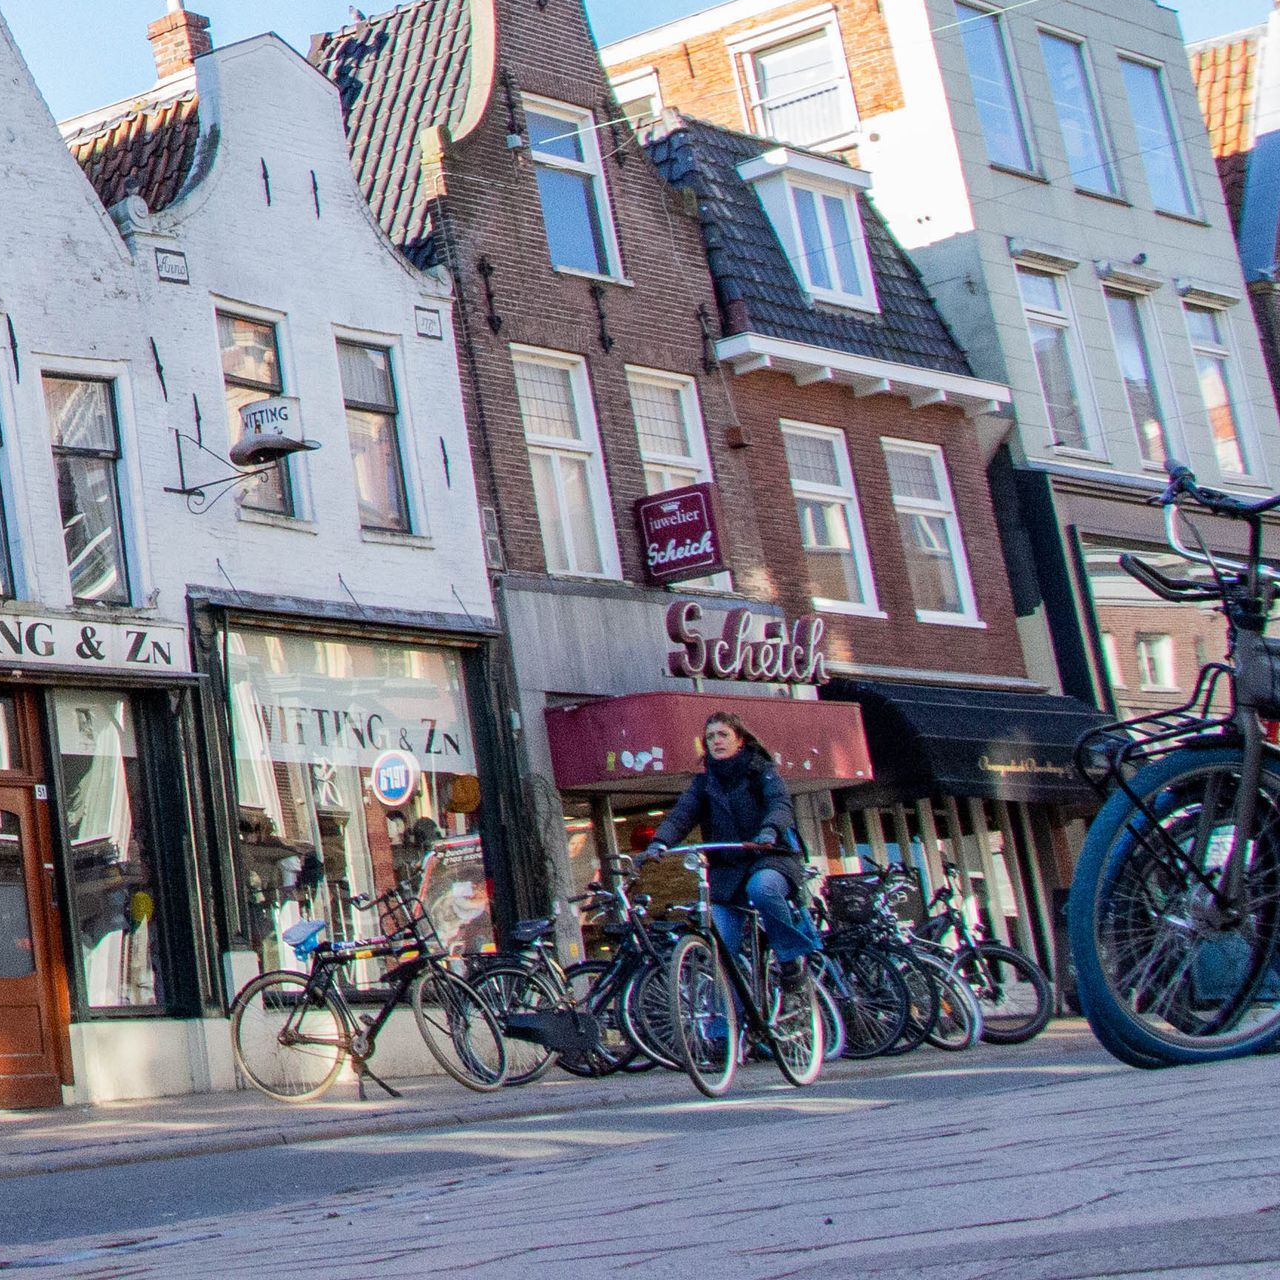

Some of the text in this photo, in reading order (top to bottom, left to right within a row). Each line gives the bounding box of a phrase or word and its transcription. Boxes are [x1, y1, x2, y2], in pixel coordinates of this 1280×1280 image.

[647, 530, 714, 566] Scheich
[75, 626, 106, 660] &
[666, 600, 831, 685] Scheich
[253, 704, 391, 750] WITTING
[399, 727, 413, 753] &
